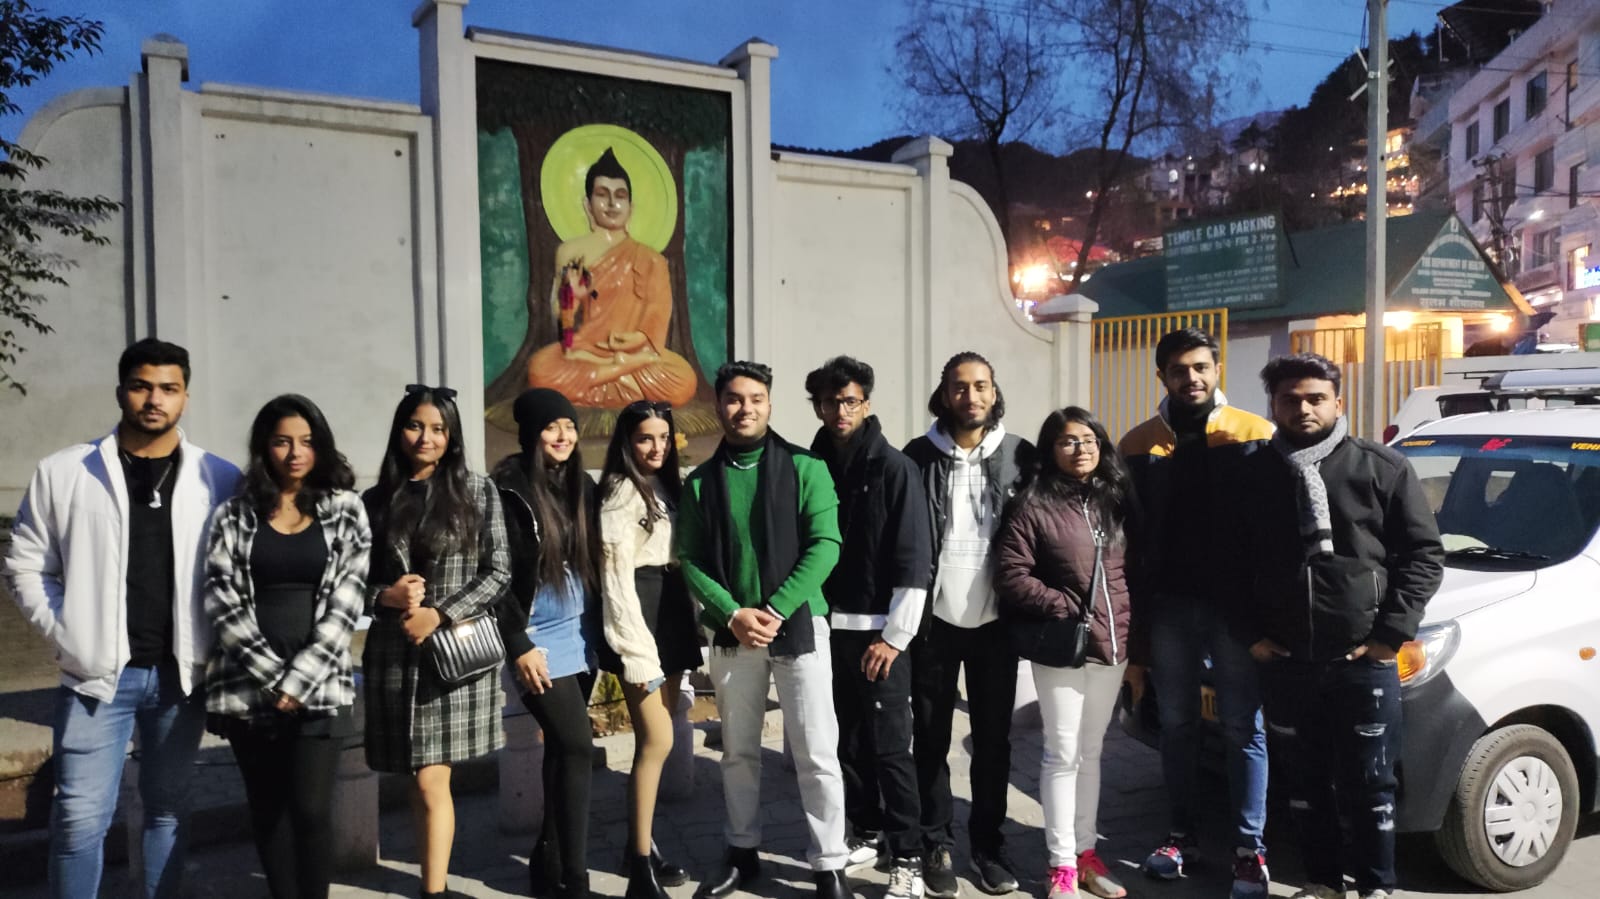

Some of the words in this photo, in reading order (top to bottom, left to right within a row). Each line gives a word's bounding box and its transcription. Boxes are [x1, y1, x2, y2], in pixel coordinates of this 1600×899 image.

[1166, 228, 1203, 247] TEMPLE
[1206, 224, 1226, 239] CAR
[1230, 215, 1276, 235] PARKING
